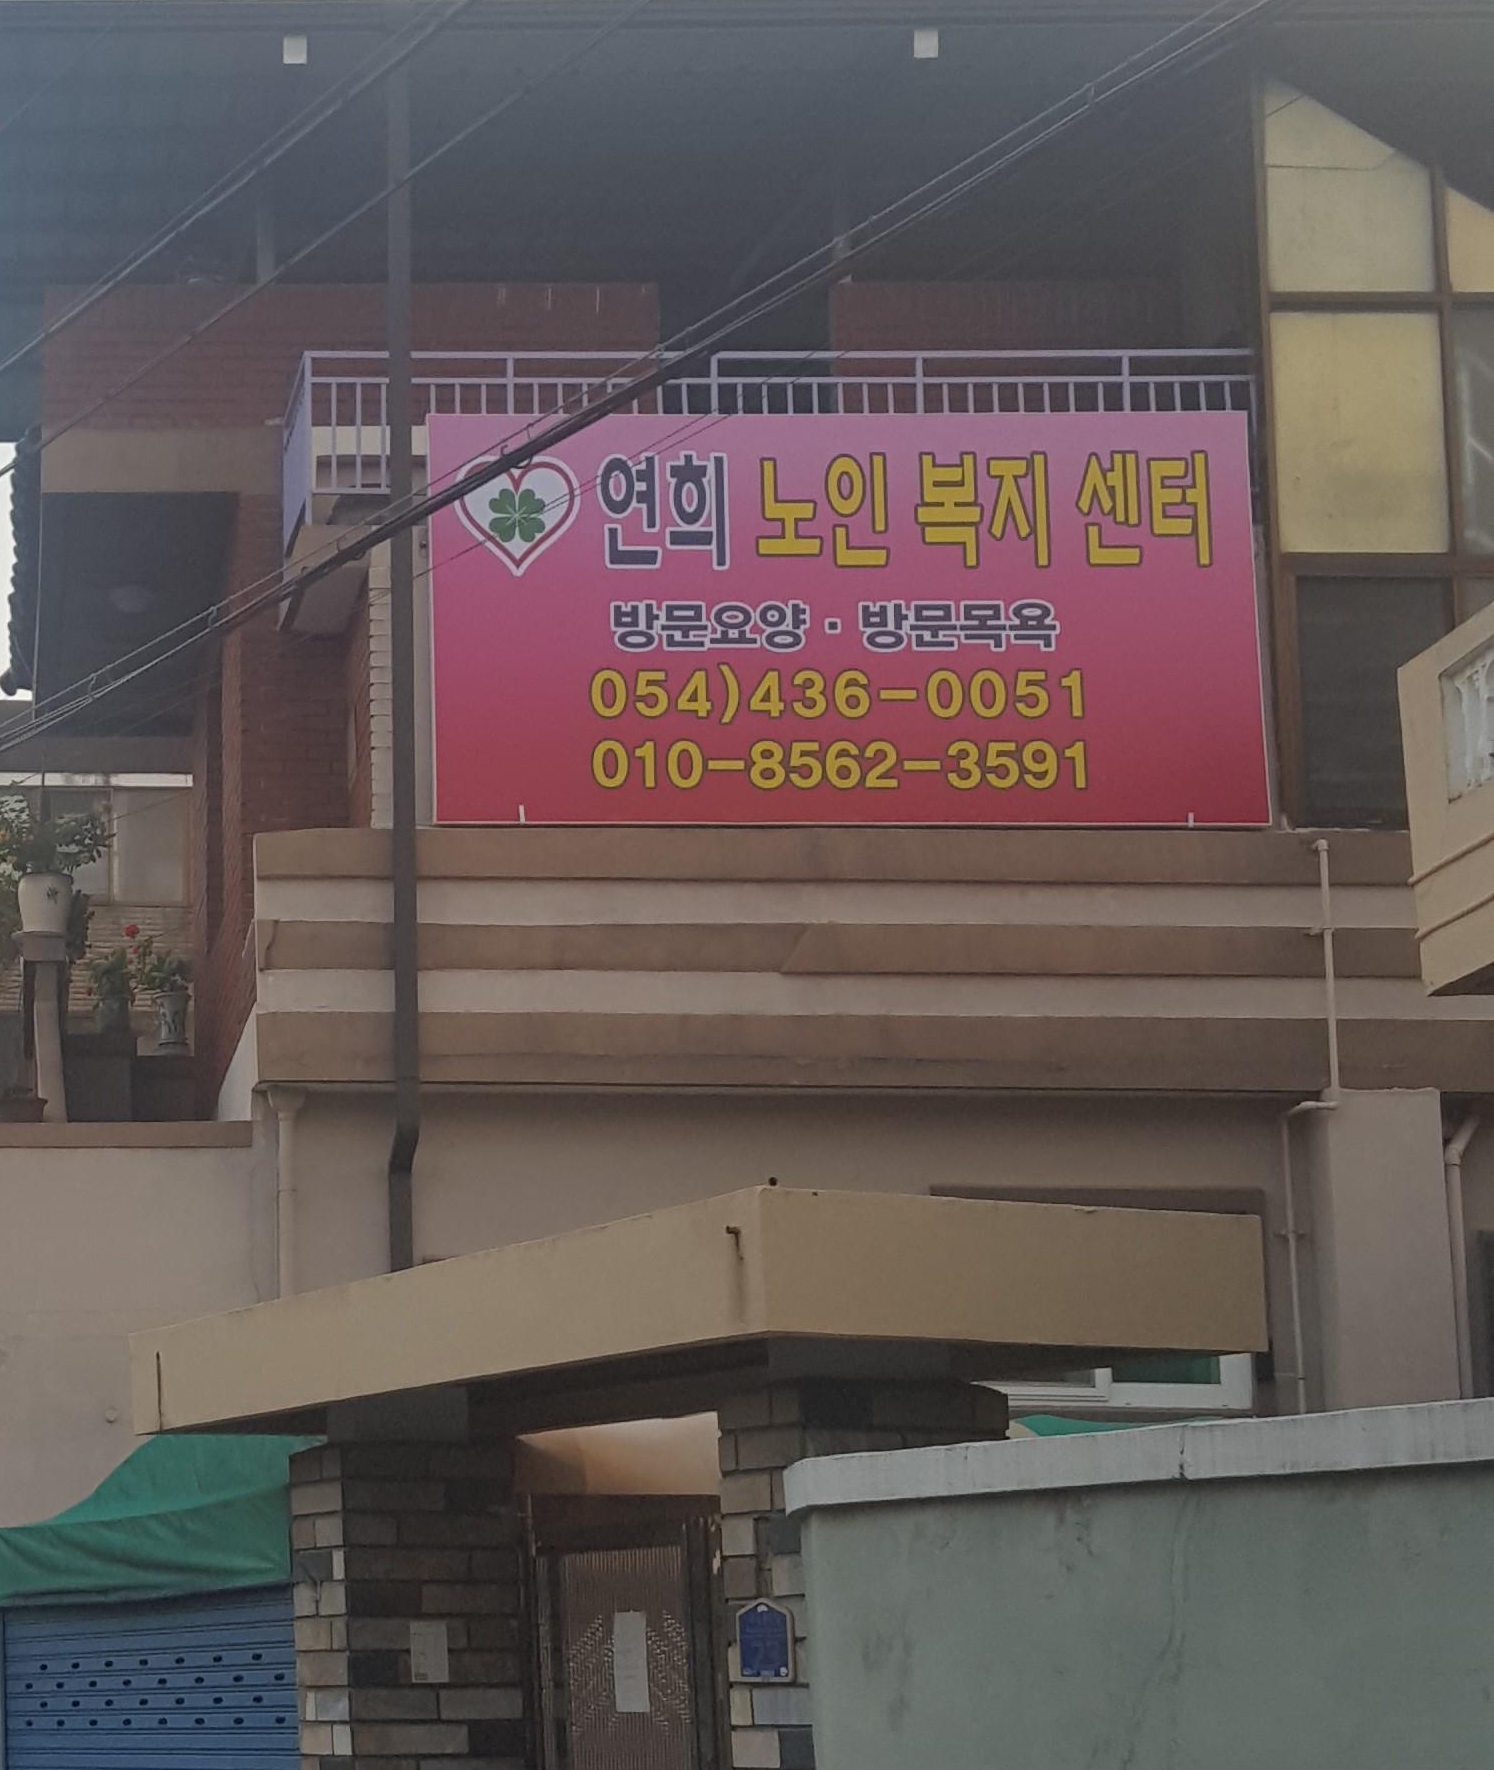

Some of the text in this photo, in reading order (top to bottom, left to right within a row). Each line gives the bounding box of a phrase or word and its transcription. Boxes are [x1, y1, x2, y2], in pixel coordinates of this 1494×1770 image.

[597, 449, 1213, 570] 연희 노인 복지 센터
[610, 600, 1060, 653] 방문요양 방문목욕
[589, 663, 1086, 725] 054)436-0051
[591, 738, 1089, 791] 010-8562-3591
